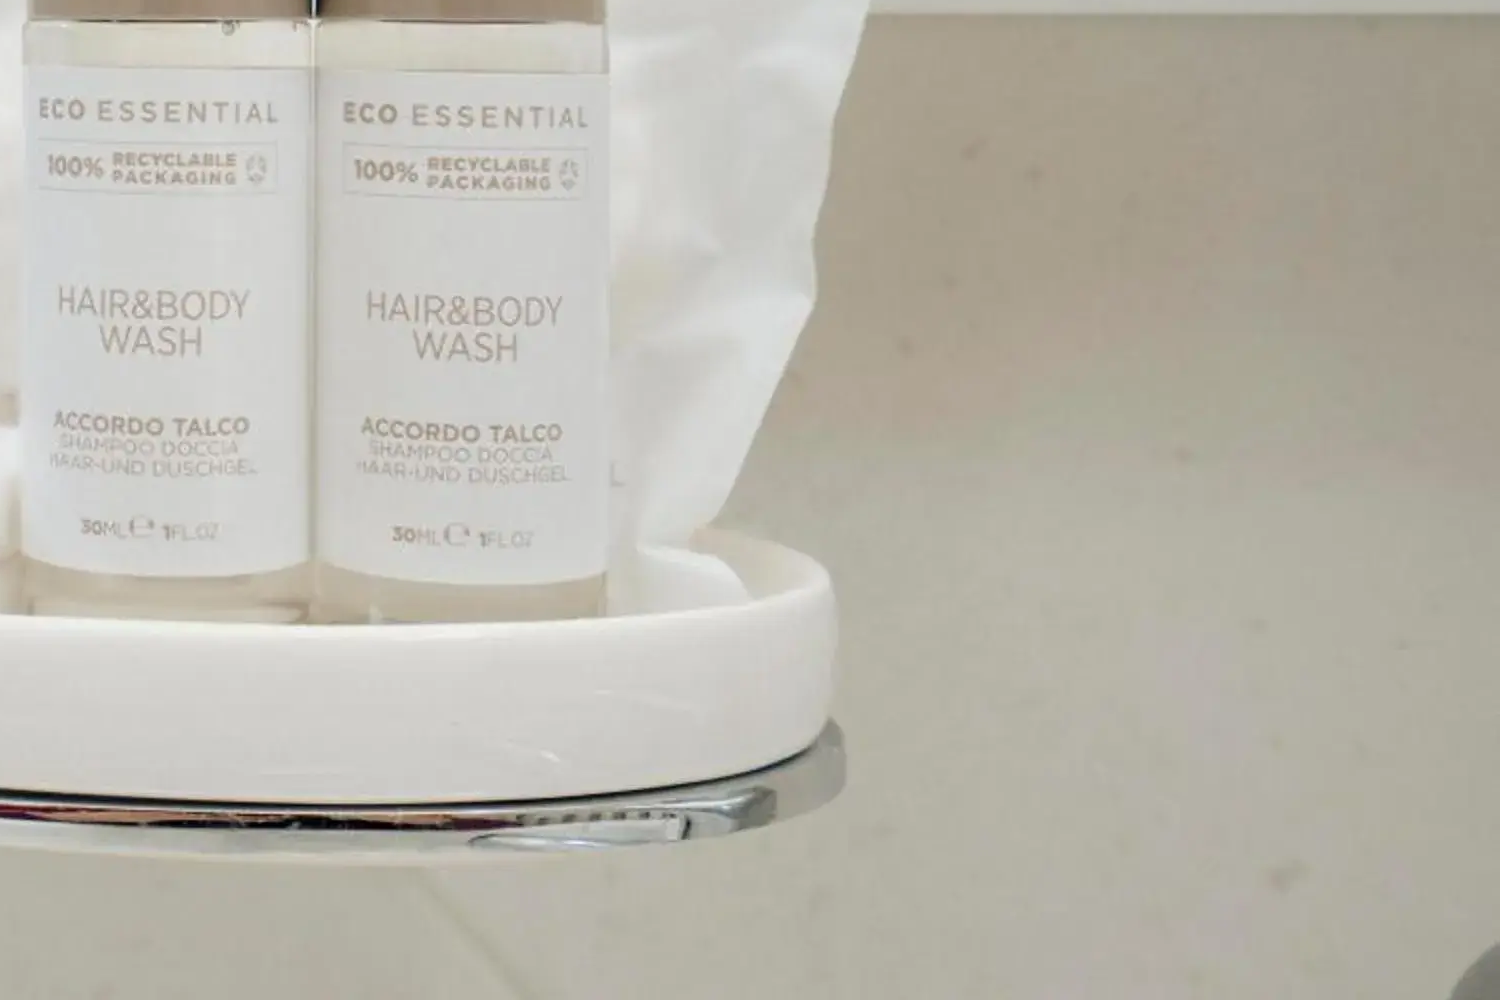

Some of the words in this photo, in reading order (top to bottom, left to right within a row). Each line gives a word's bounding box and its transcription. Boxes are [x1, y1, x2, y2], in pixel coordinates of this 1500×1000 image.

[38, 97, 85, 121] ECO
[97, 100, 279, 123] ESSENTIAL
[343, 101, 398, 124] ECO
[412, 103, 588, 128] ESSENTIAL
[47, 153, 105, 179] 100%
[112, 152, 237, 167] RECYCLABLE
[353, 158, 419, 183] 100%
[426, 157, 551, 173] RECYCLABLE
[112, 170, 237, 185] PACKAGING
[426, 175, 551, 191] PACKAGING
[58, 286, 249, 321] HAIR&BODY
[367, 290, 563, 327] HAIR&BODY
[99, 325, 202, 357] WASH
[413, 331, 518, 363] WASH
[53, 409, 165, 436] ACCORDO
[173, 416, 251, 437] TALCO
[360, 416, 481, 442] ACCORDO
[489, 423, 563, 443] TALCO
[59, 435, 155, 455] SHAMPOO
[161, 440, 239, 457] DOCCIA
[369, 440, 471, 463] SHAMPOO
[478, 447, 554, 463] DOCCIA
[468, 465, 573, 486] DUSCHGEL
